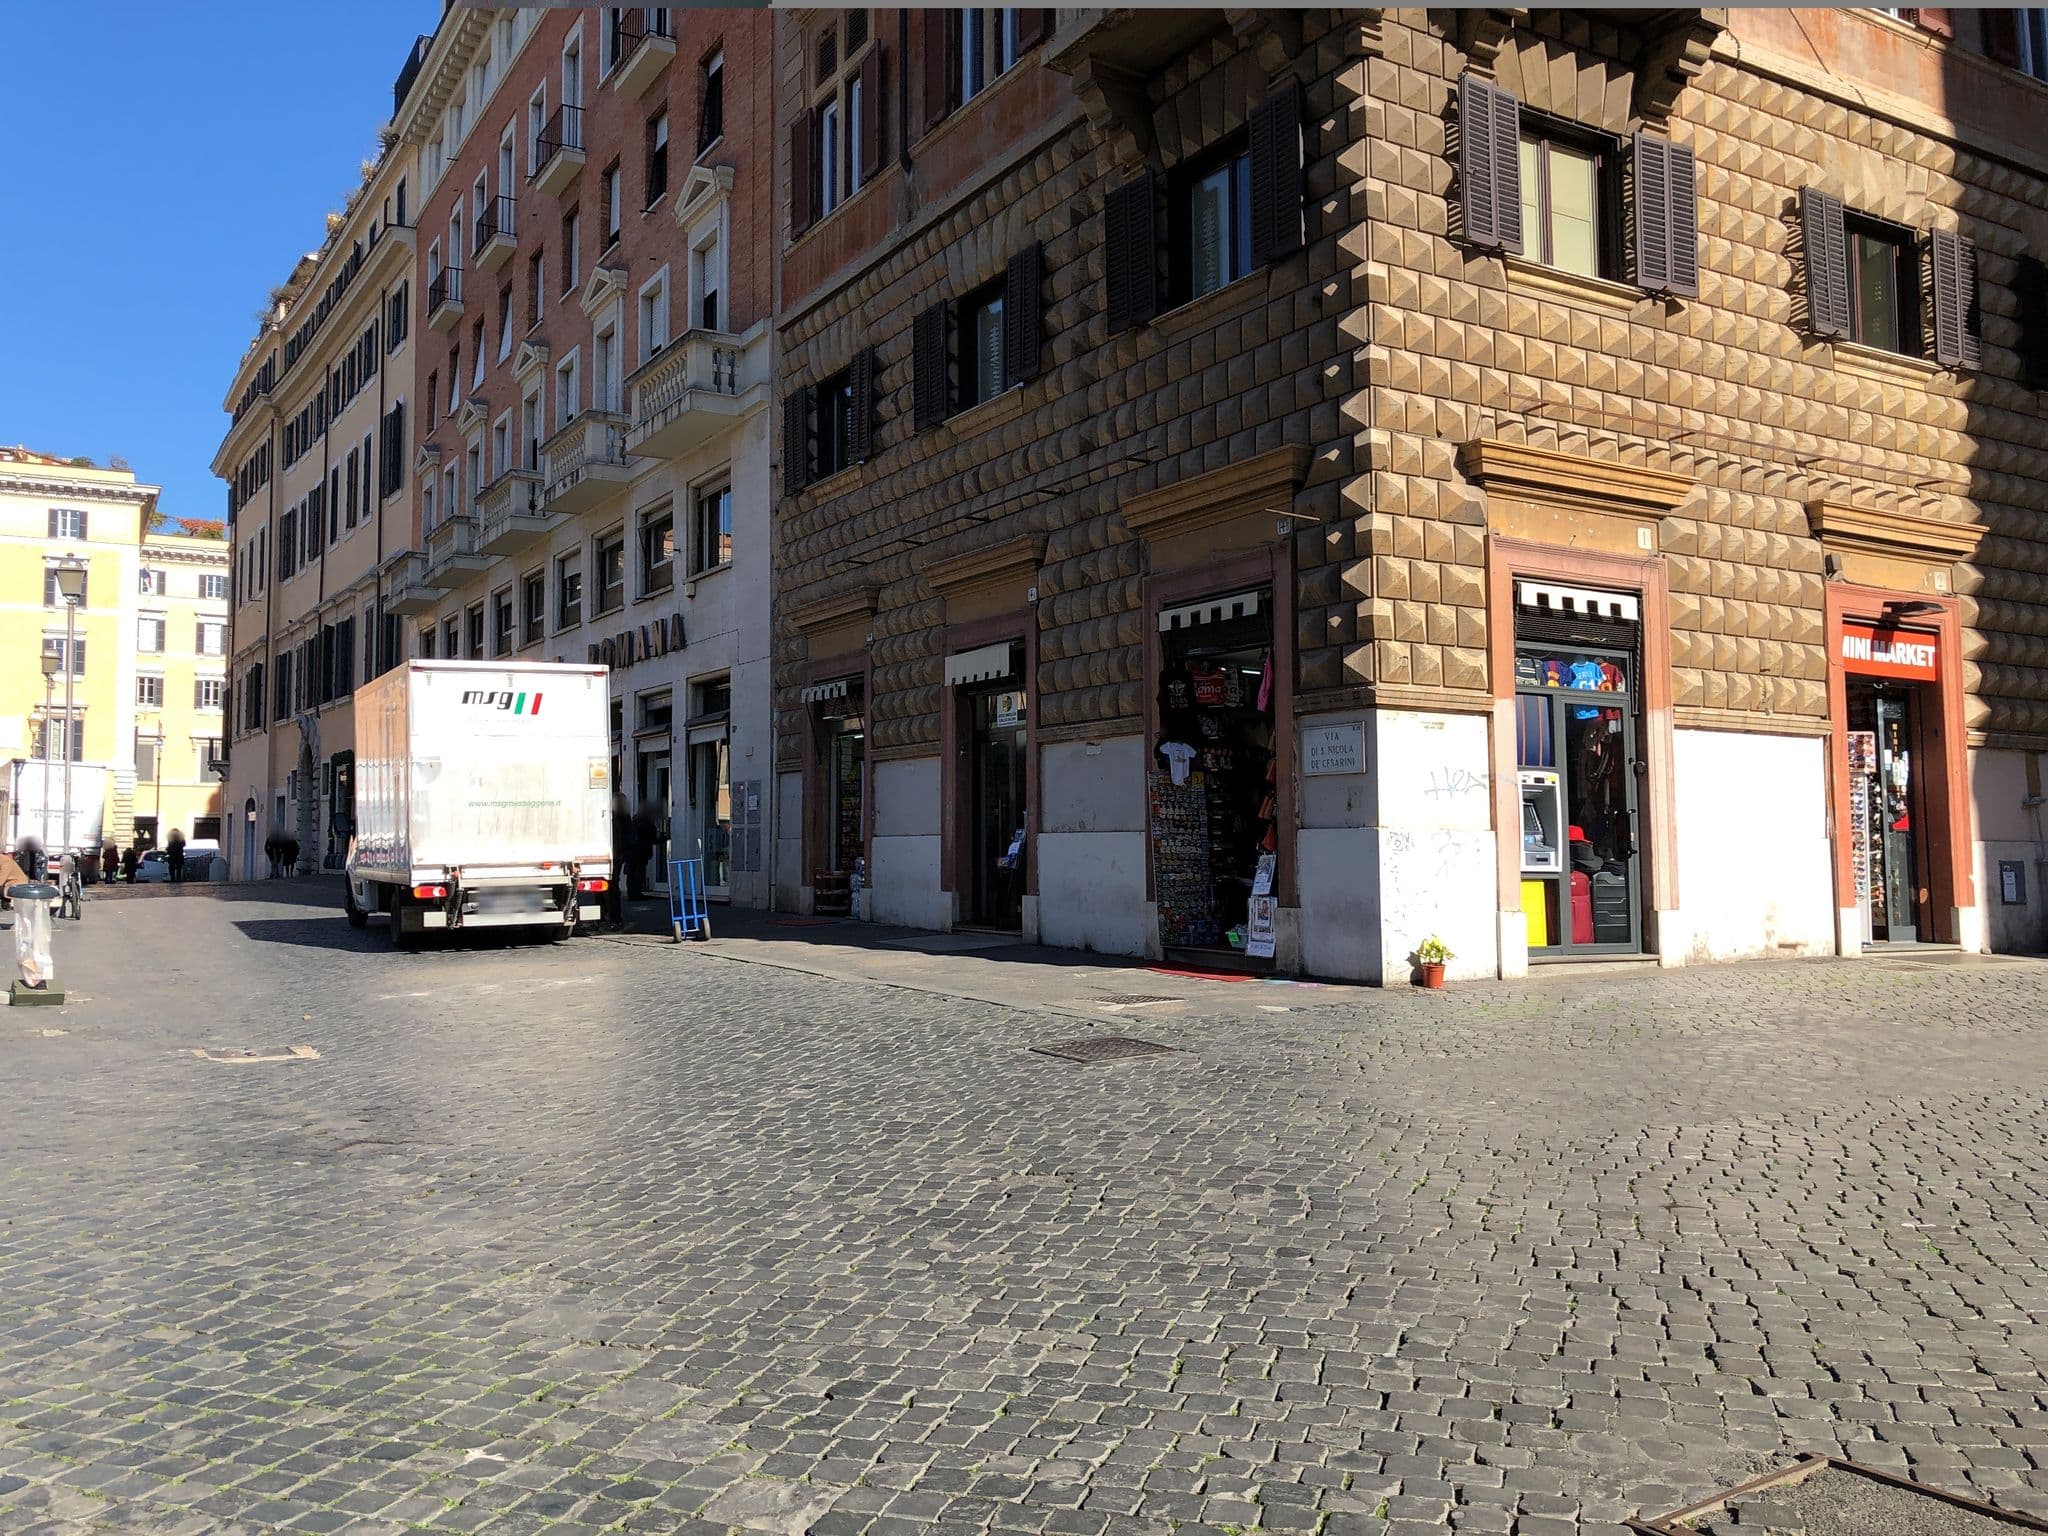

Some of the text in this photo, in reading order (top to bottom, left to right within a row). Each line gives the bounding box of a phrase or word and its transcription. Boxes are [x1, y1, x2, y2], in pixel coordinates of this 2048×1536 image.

[1873, 640, 1936, 668] MARKET
[461, 690, 514, 710] msg
[1324, 731, 1339, 741] VIA
[1311, 746, 1319, 757] DI
[1327, 744, 1354, 754] NICOLA
[1322, 757, 1355, 768] CESARINI
